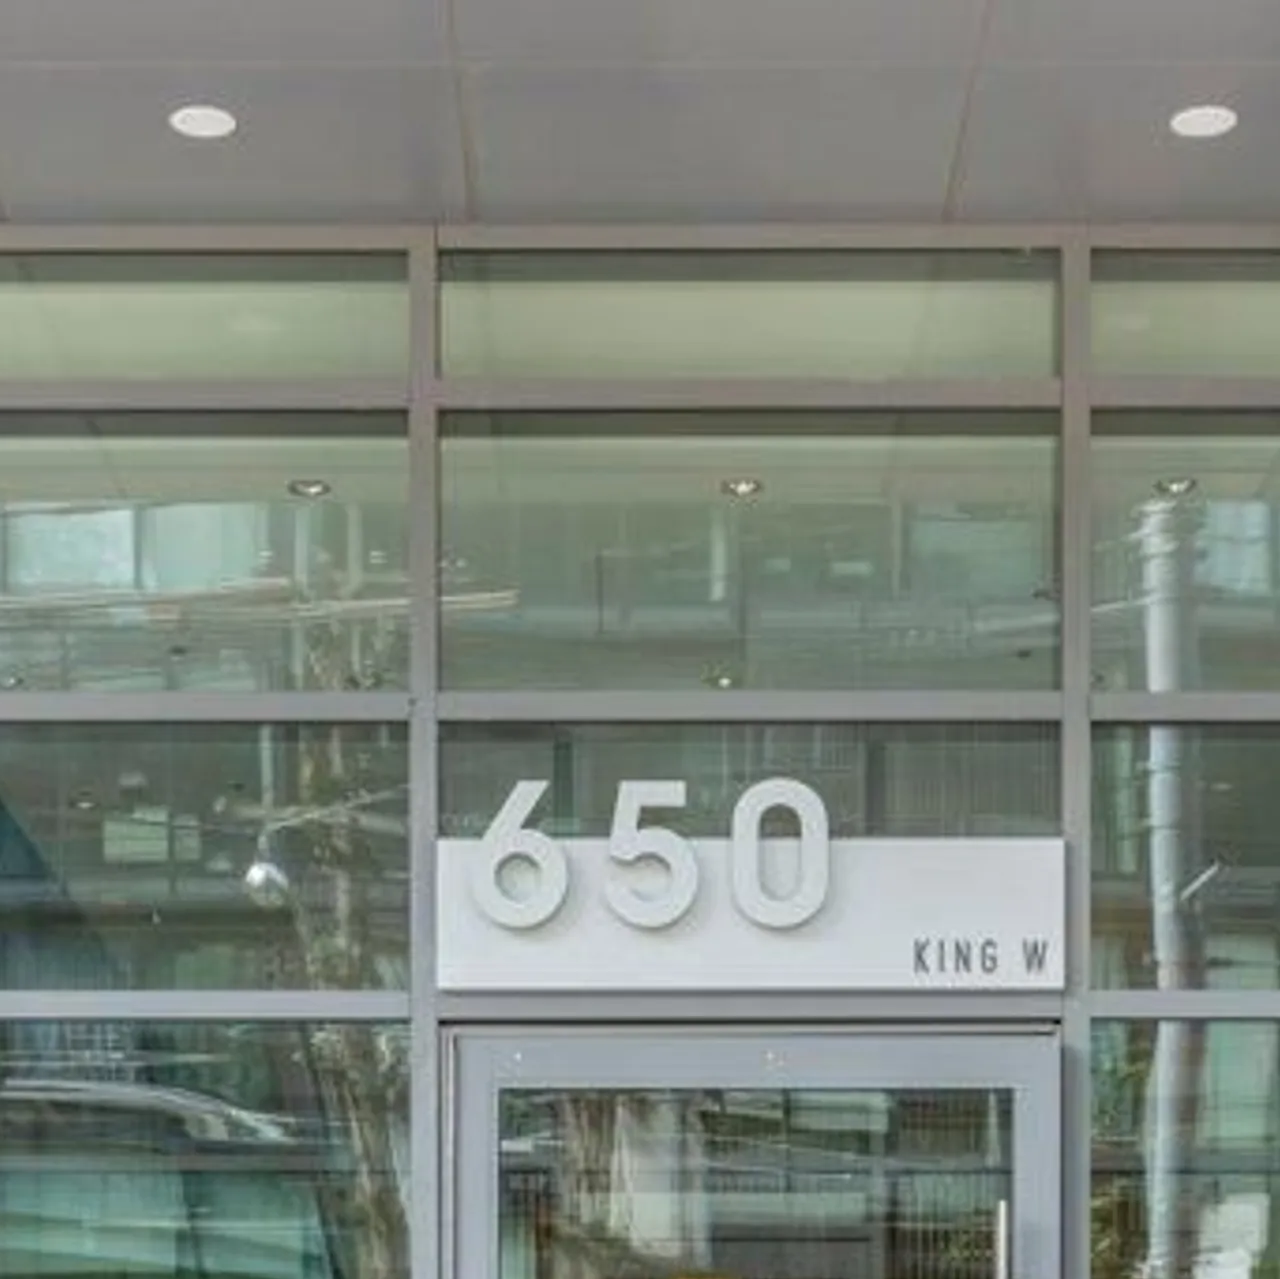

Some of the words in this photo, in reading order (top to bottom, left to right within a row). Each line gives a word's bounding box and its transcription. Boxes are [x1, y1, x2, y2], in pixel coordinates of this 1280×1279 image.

[475, 777, 830, 929] 650
[914, 940, 998, 974] KING
[1023, 940, 1049, 973] W
